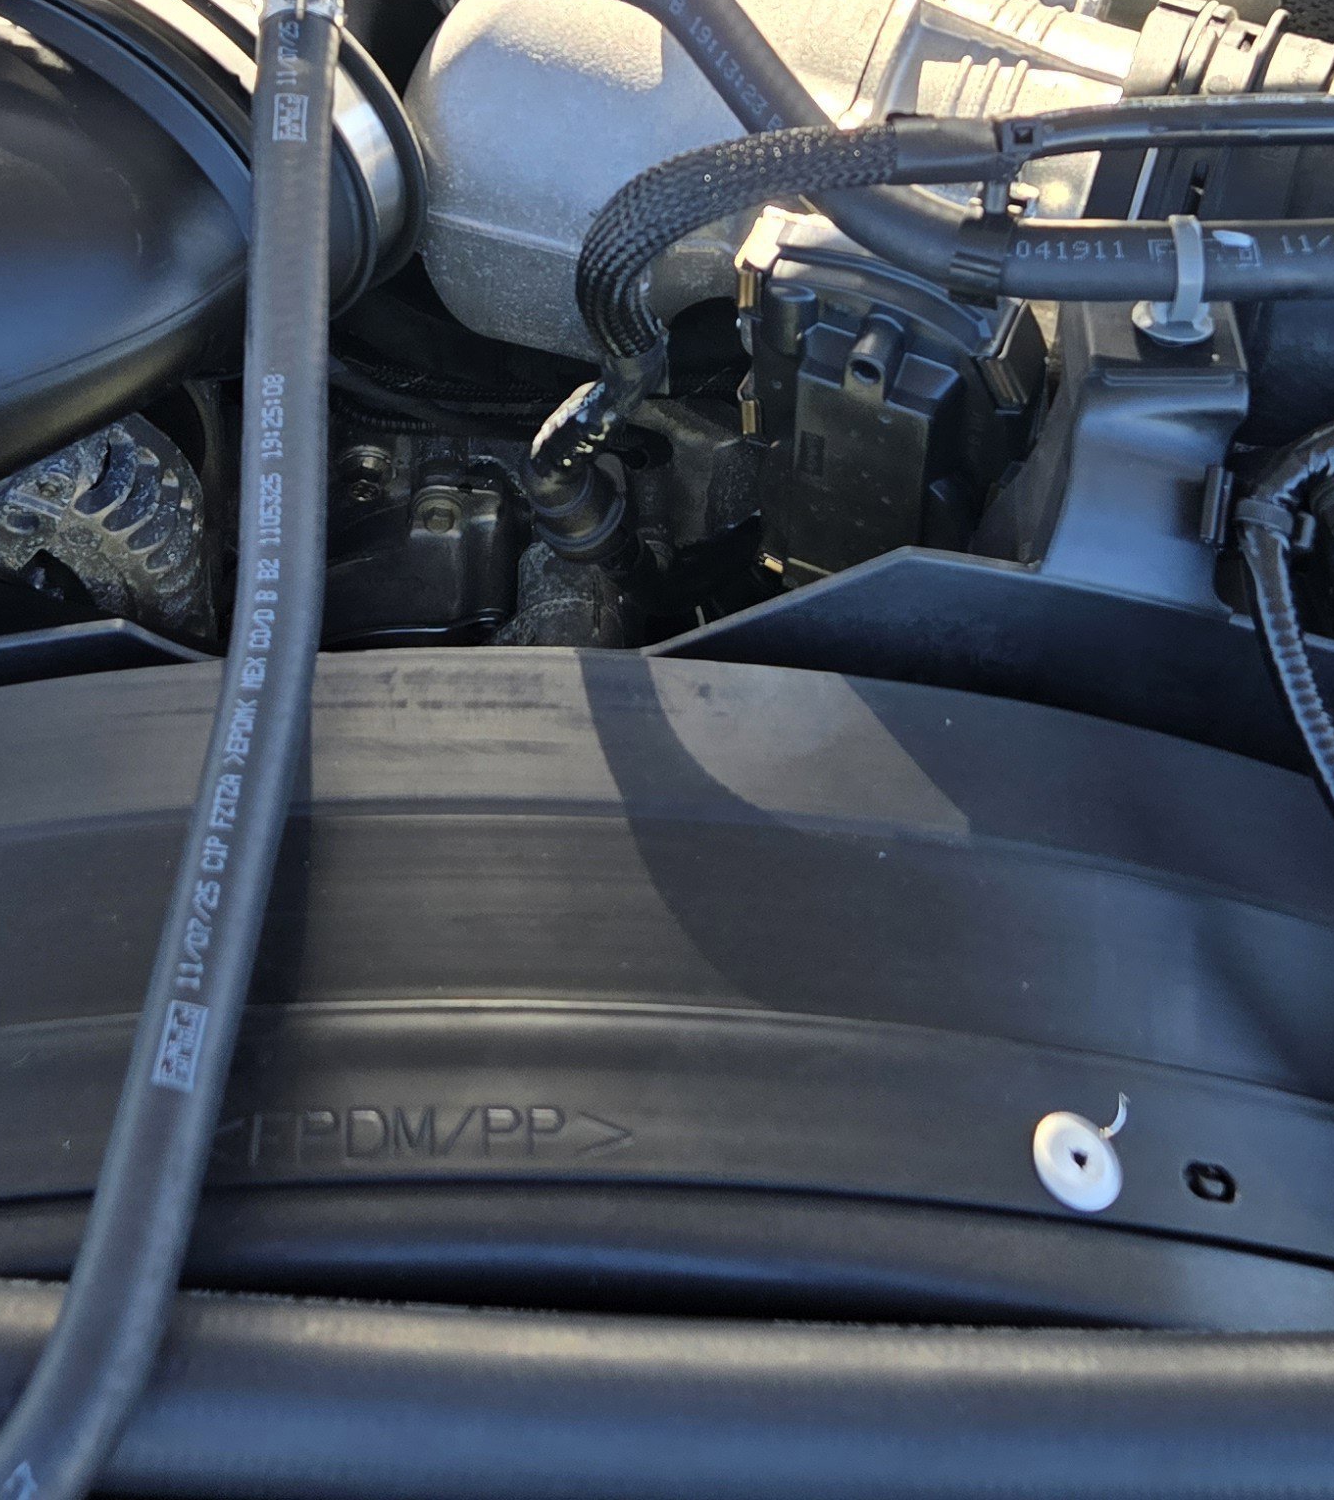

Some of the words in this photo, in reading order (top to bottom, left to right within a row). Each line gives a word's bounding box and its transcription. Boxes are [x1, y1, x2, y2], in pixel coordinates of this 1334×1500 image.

[1006, 238, 1126, 261] 041911
[257, 558, 280, 581] B2
[255, 589, 279, 605] B
[239, 656, 267, 691] MEX
[200, 835, 230, 874] CIP
